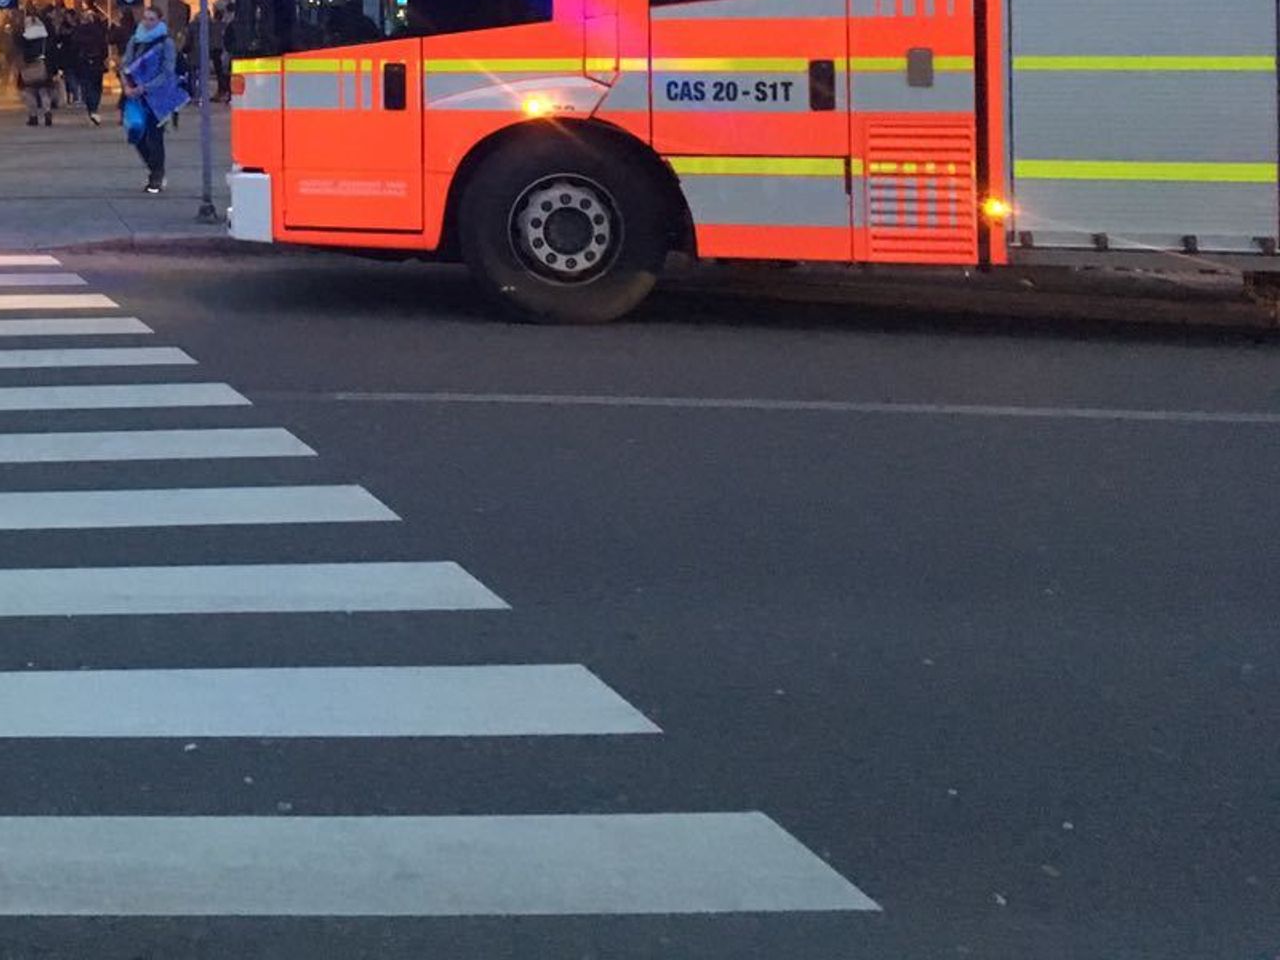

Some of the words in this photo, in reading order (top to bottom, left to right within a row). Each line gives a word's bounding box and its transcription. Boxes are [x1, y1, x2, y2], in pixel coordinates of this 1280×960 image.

[666, 80, 706, 102] CAS
[712, 81, 738, 102] 20
[754, 81, 794, 102] S1T
